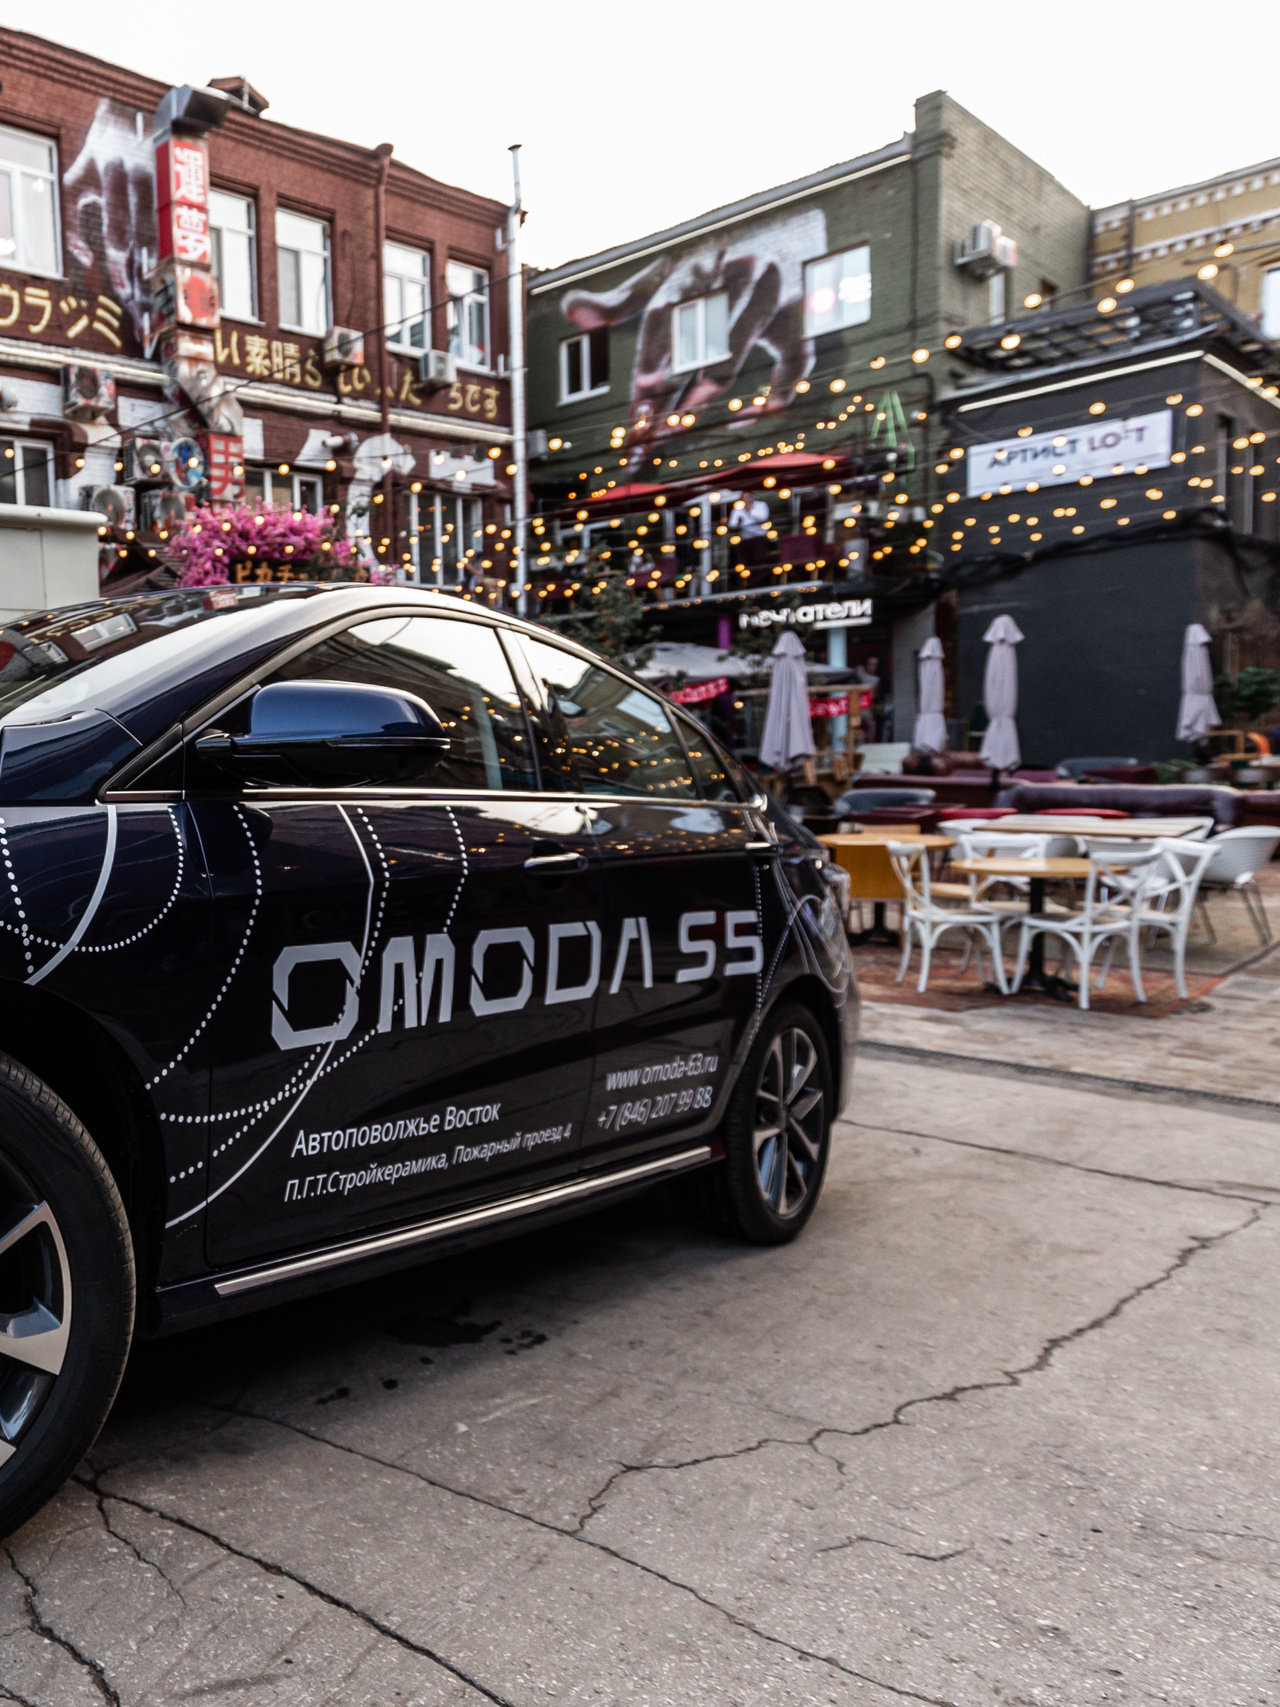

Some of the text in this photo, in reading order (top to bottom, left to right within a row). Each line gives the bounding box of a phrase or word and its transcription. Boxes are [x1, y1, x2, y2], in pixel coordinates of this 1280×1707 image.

[988, 438, 1080, 468] АРТИСТ
[271, 916, 654, 1051] OMODA
[291, 1102, 501, 1158] Автоповолжье Восток
[597, 1086, 713, 1131] +7 (846) 207 99 88
[451, 1132, 521, 1165] Пожарный
[521, 1126, 563, 1150] проезд
